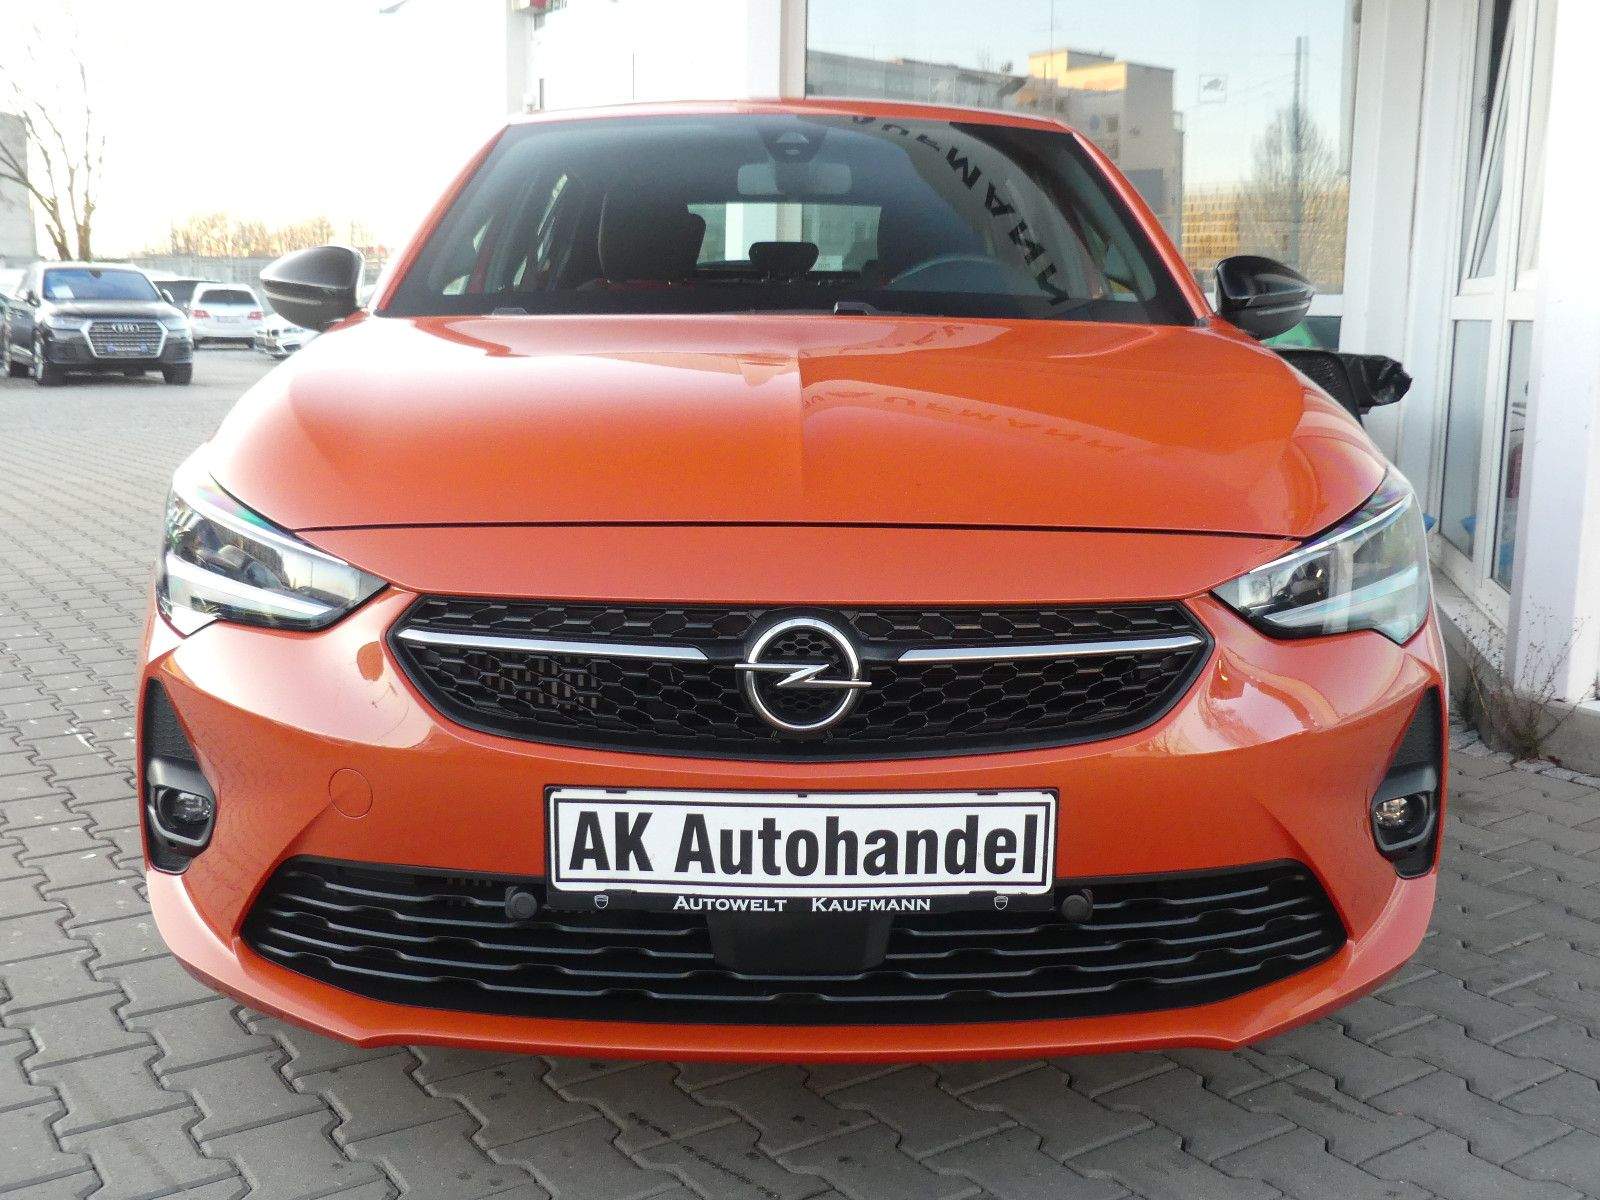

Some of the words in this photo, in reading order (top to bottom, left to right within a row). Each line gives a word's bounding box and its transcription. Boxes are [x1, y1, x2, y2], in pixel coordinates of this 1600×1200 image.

[569, 811, 654, 872] AK
[674, 813, 1038, 876] Autohandel
[673, 895, 787, 912] AUTOWELT
[811, 897, 931, 912] KAUFMANN
